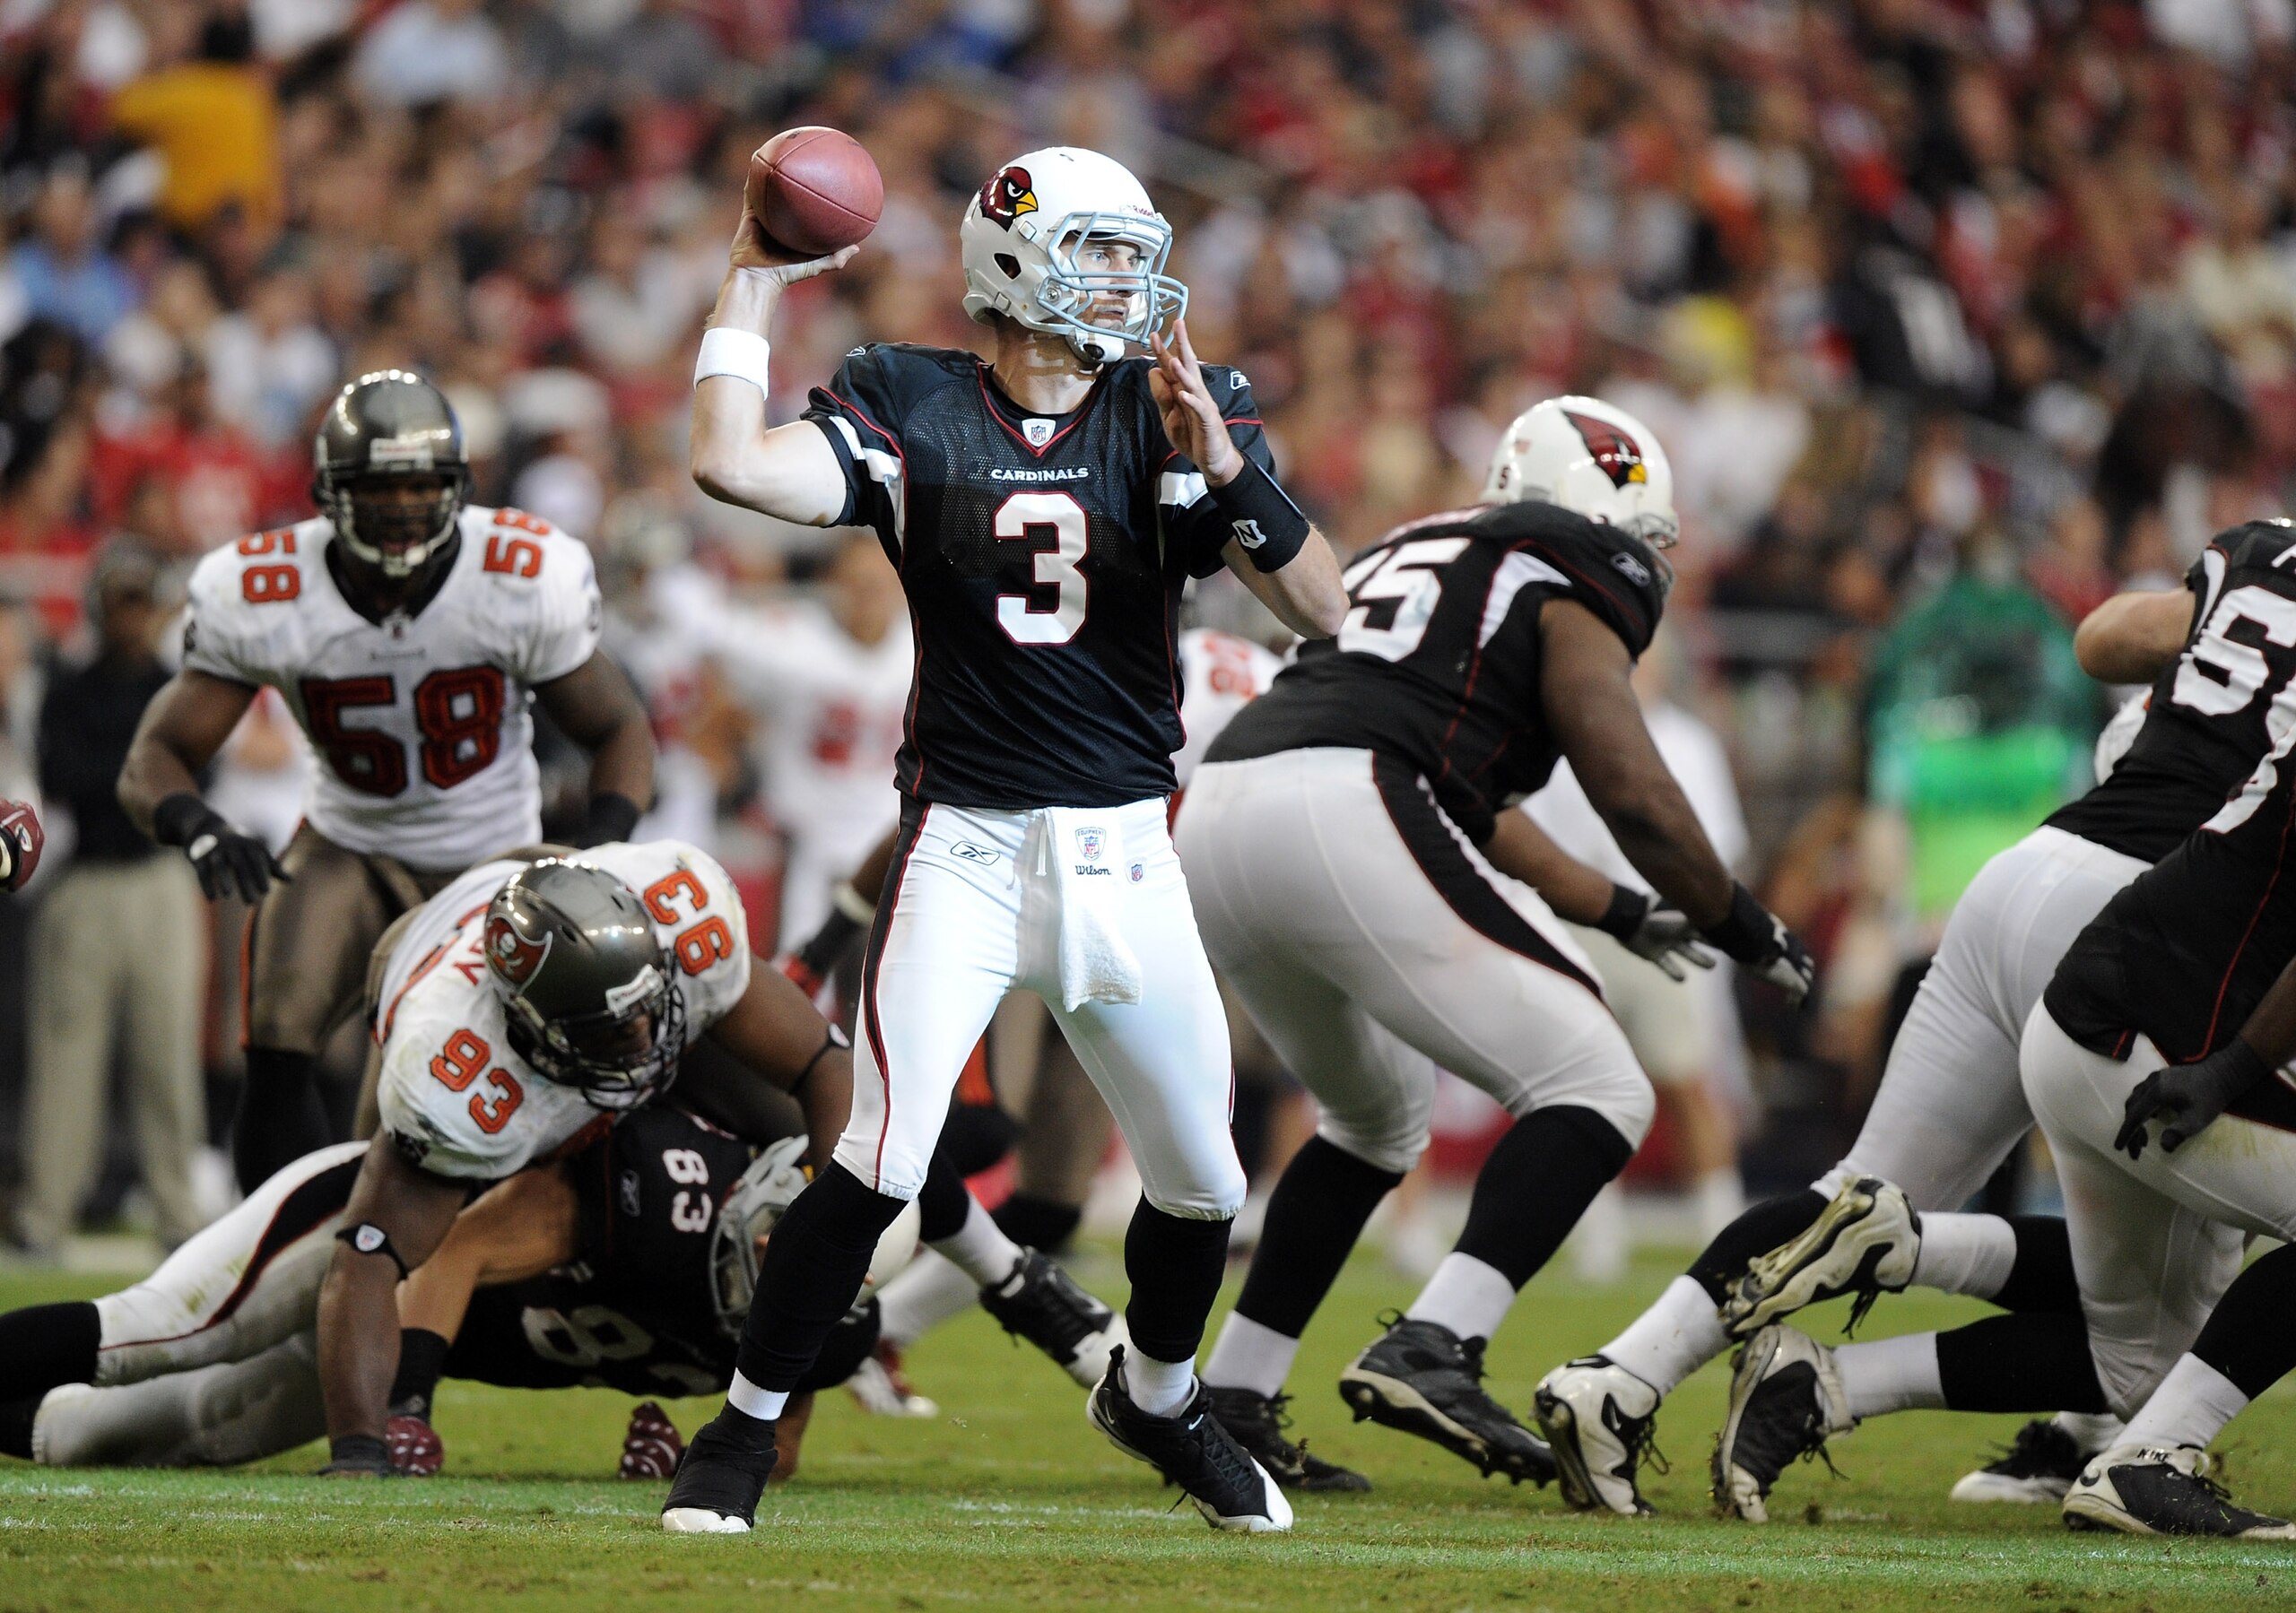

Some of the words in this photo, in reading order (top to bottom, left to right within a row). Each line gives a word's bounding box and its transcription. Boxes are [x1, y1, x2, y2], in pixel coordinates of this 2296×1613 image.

[991, 467, 1089, 481] CARDINALS
[993, 490, 1090, 646] 3
[300, 662, 506, 799] 58
[643, 869, 735, 977] 93
[1075, 864, 1111, 875] Wilson
[430, 1028, 525, 1135] 93
[662, 1148, 714, 1234] 83
